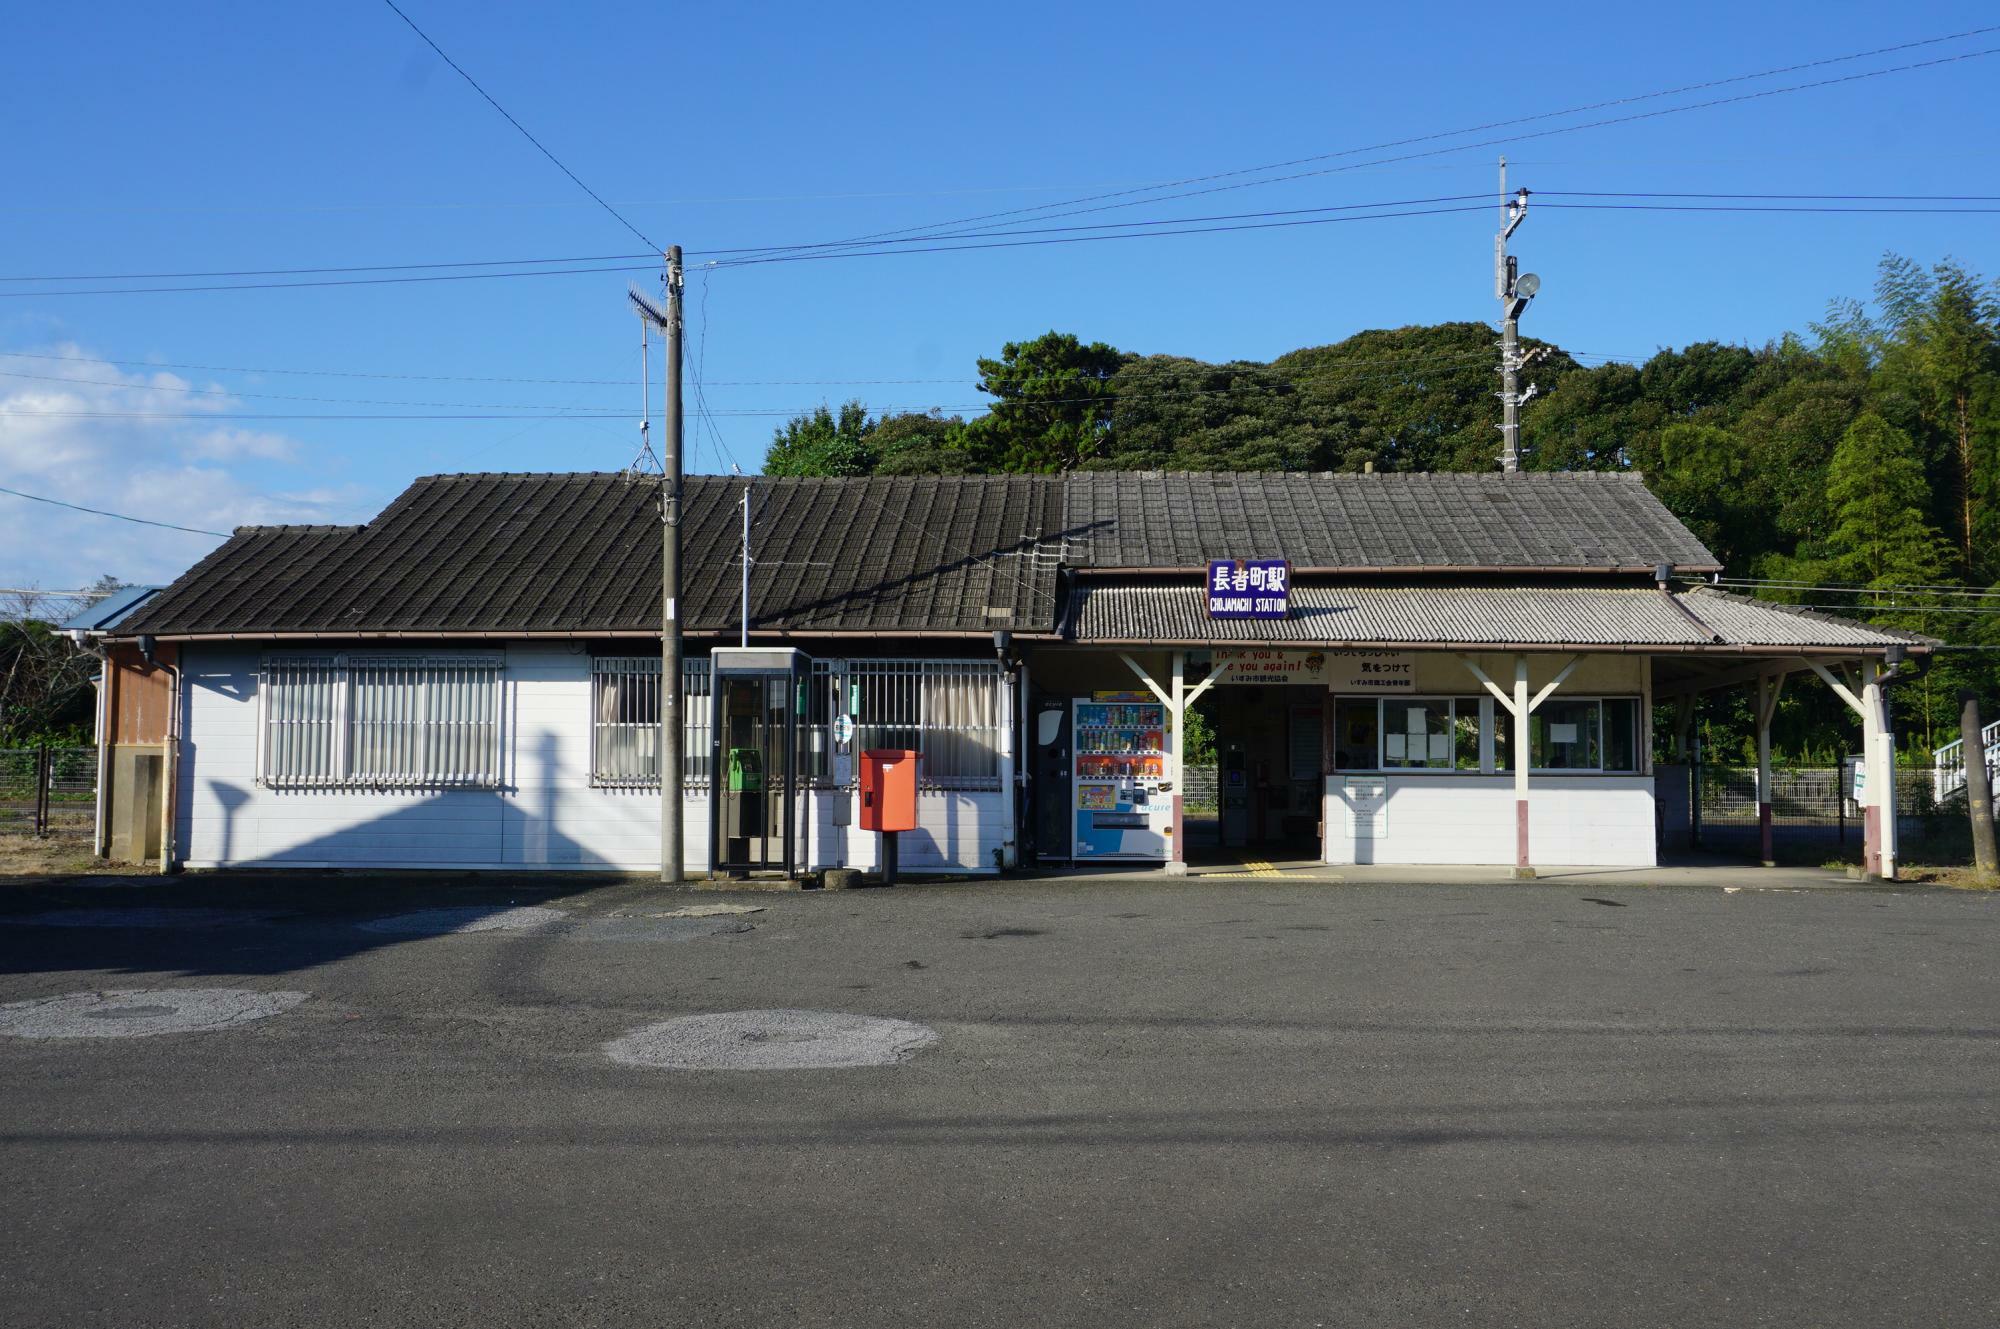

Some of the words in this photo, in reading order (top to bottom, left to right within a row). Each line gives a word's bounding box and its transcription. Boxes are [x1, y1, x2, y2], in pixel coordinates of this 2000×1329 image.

[1213, 566, 1286, 592] 長者町駅
[1255, 598, 1286, 612] STATION
[1252, 650, 1271, 660] you
[1240, 663, 1258, 673] you
[1263, 660, 1301, 672] again!
[1361, 662, 1411, 673] 気をつけて
[1141, 804, 1171, 812] acure
